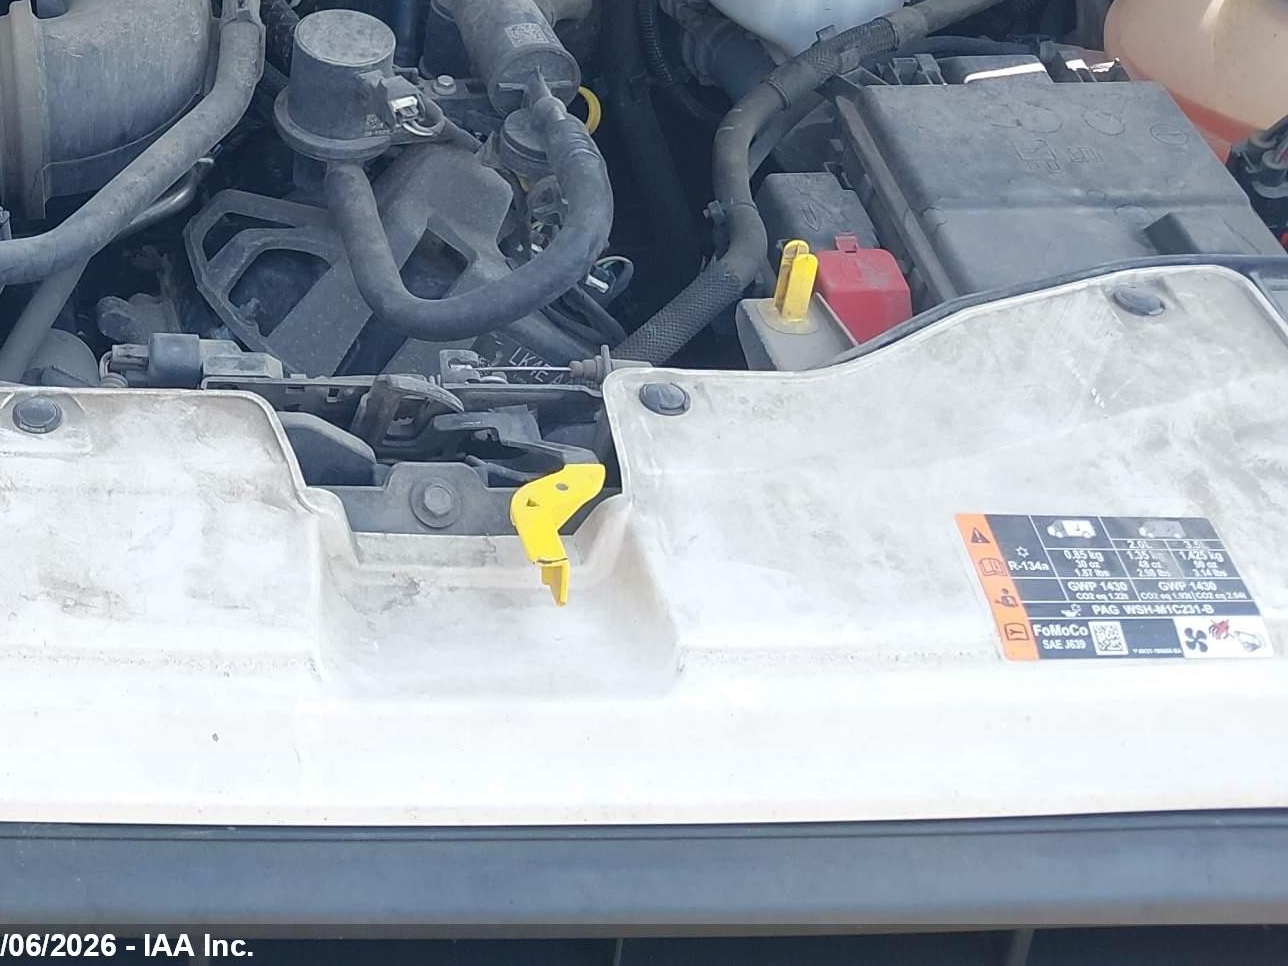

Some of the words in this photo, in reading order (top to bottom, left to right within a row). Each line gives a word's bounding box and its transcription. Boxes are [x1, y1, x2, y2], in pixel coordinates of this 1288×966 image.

[1064, 550, 1088, 560] 0.85
[1088, 550, 1105, 563] kg
[1207, 550, 1225, 563] kg
[1007, 560, 1051, 571] R-134a
[1067, 581, 1097, 592] GWP
[1099, 581, 1128, 592] 1430
[1158, 581, 1187, 592] GWP
[1188, 581, 1218, 592] 1430
[1075, 592, 1095, 601] CO2
[1140, 592, 1160, 601] CO2
[1195, 592, 1215, 601] CO2
[1091, 604, 1120, 616] PAG
[1032, 623, 1089, 637] FoMoCo
[1042, 639, 1064, 650] SAE
